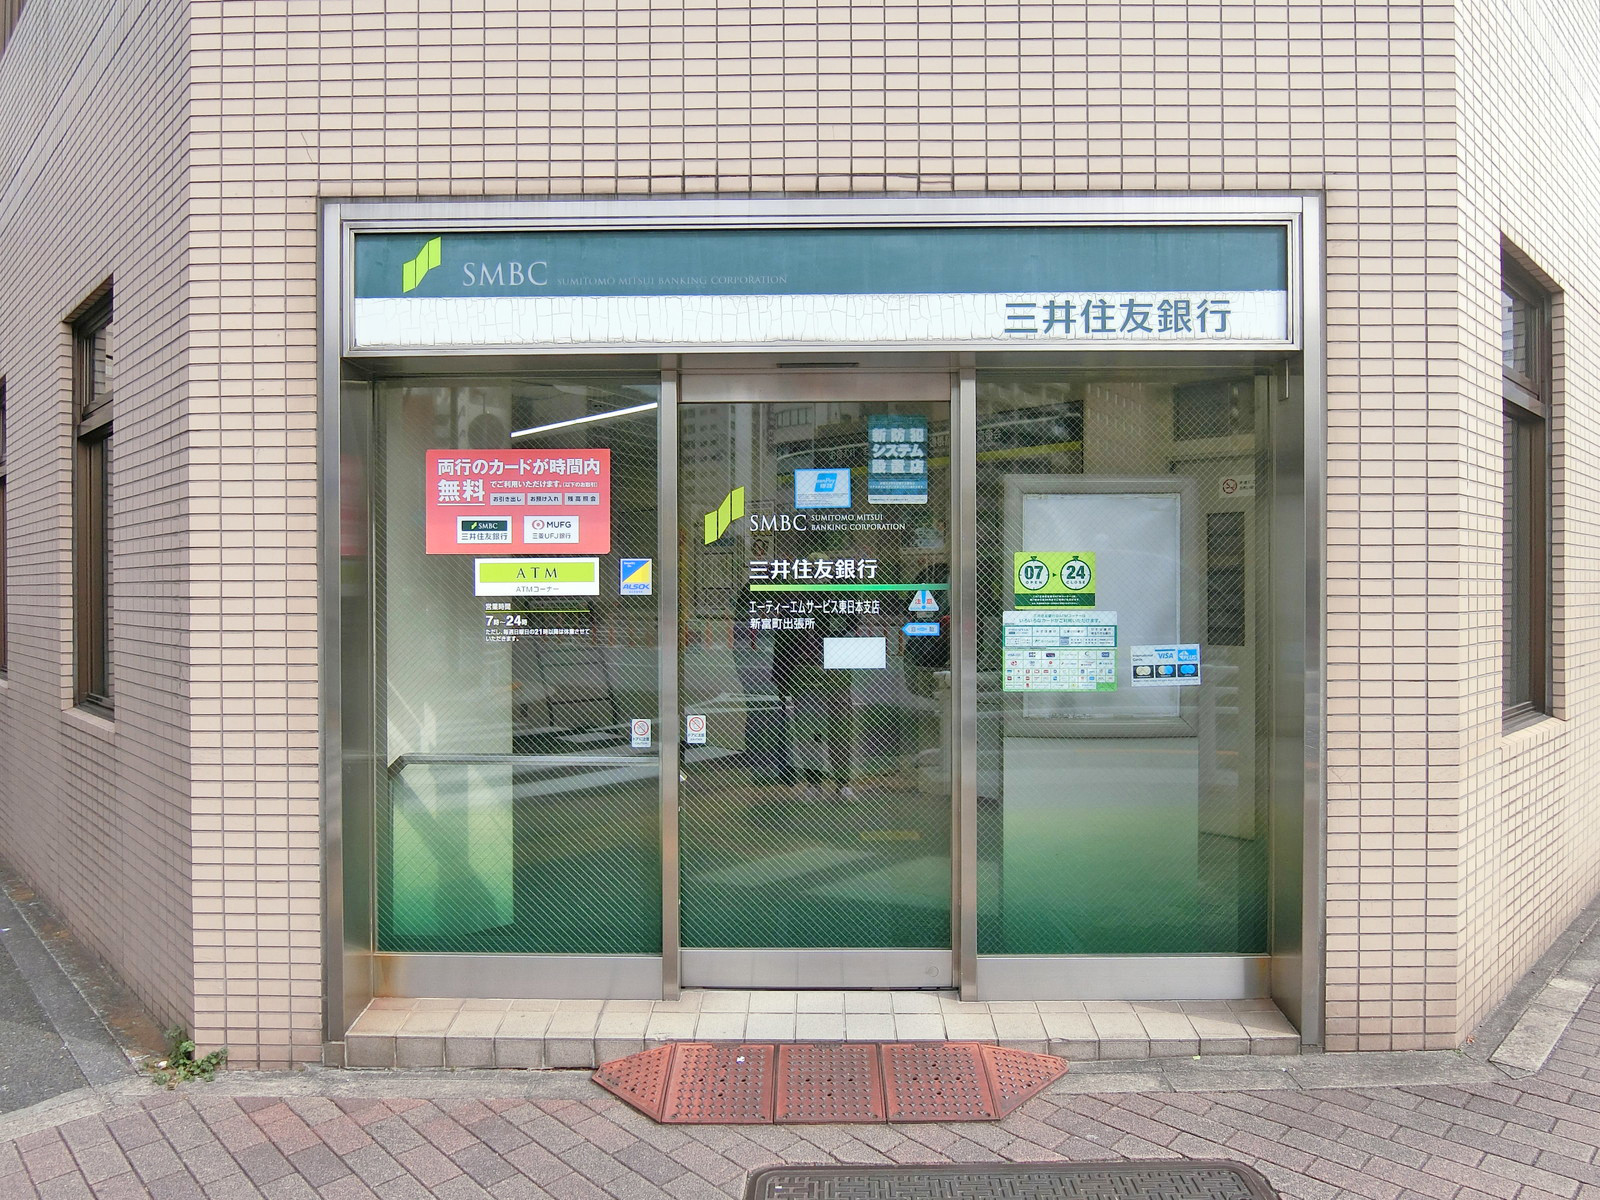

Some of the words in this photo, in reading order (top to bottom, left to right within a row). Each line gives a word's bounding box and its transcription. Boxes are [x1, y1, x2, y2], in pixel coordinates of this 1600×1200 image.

[462, 261, 548, 287] SMBC
[557, 276, 616, 286] SUMITOMO
[618, 276, 655, 286] MITSUI
[658, 276, 708, 285] BANKING
[710, 275, 788, 285] CORPORATION
[1004, 298, 1232, 334] 三井住友銀行
[871, 443, 925, 458] システム
[437, 458, 600, 476] 両行のカードが時間内
[437, 479, 485, 502] 無料
[493, 495, 522, 503] お引き出し
[750, 514, 807, 532] SMBC
[856, 513, 883, 521] MITSUI
[478, 522, 498, 530] SMBC
[546, 521, 572, 529] MUFG
[811, 523, 847, 531] BANKING
[849, 523, 906, 531] CORPORATION
[461, 532, 508, 541] 三井住友銀行
[532, 532, 572, 540] 三菱UFJ銀行
[516, 567, 559, 579] ATM
[749, 559, 878, 580] 三井住友銀行
[1025, 565, 1044, 580] 07
[1066, 565, 1086, 580] 24
[485, 603, 512, 611] 営業時間
[749, 600, 880, 615] エーティーエムサービス東日本支店
[749, 618, 816, 630] 新富町出張所
